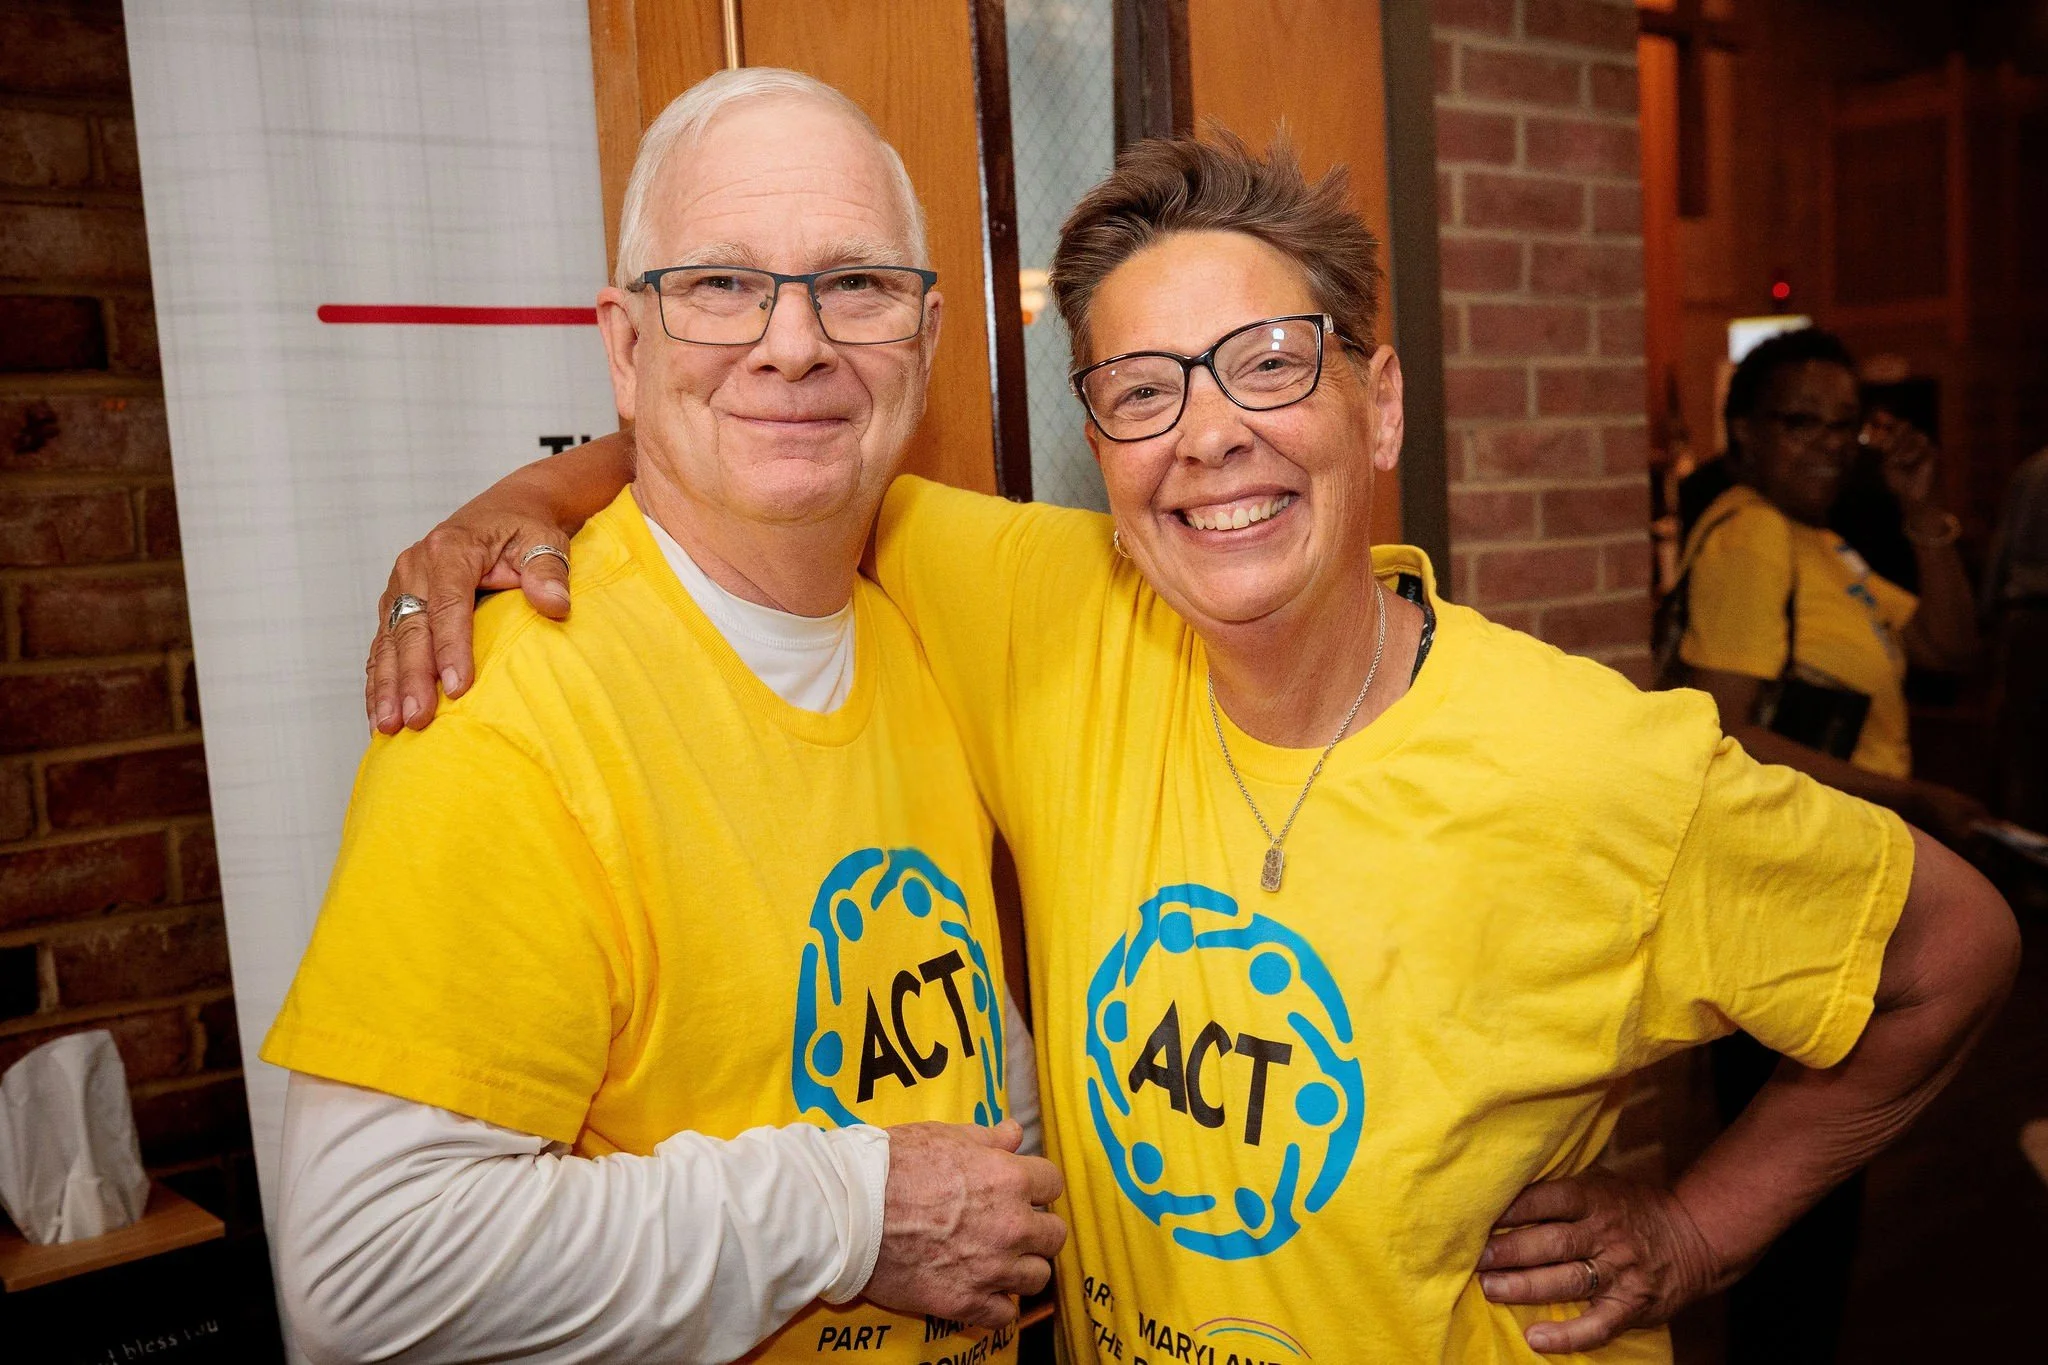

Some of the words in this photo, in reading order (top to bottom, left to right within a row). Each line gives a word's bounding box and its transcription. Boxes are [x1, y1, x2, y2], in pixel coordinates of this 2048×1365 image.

[856, 949, 976, 1104] ACT
[1128, 1000, 1293, 1147] ACT
[817, 1325, 891, 1351] PART
